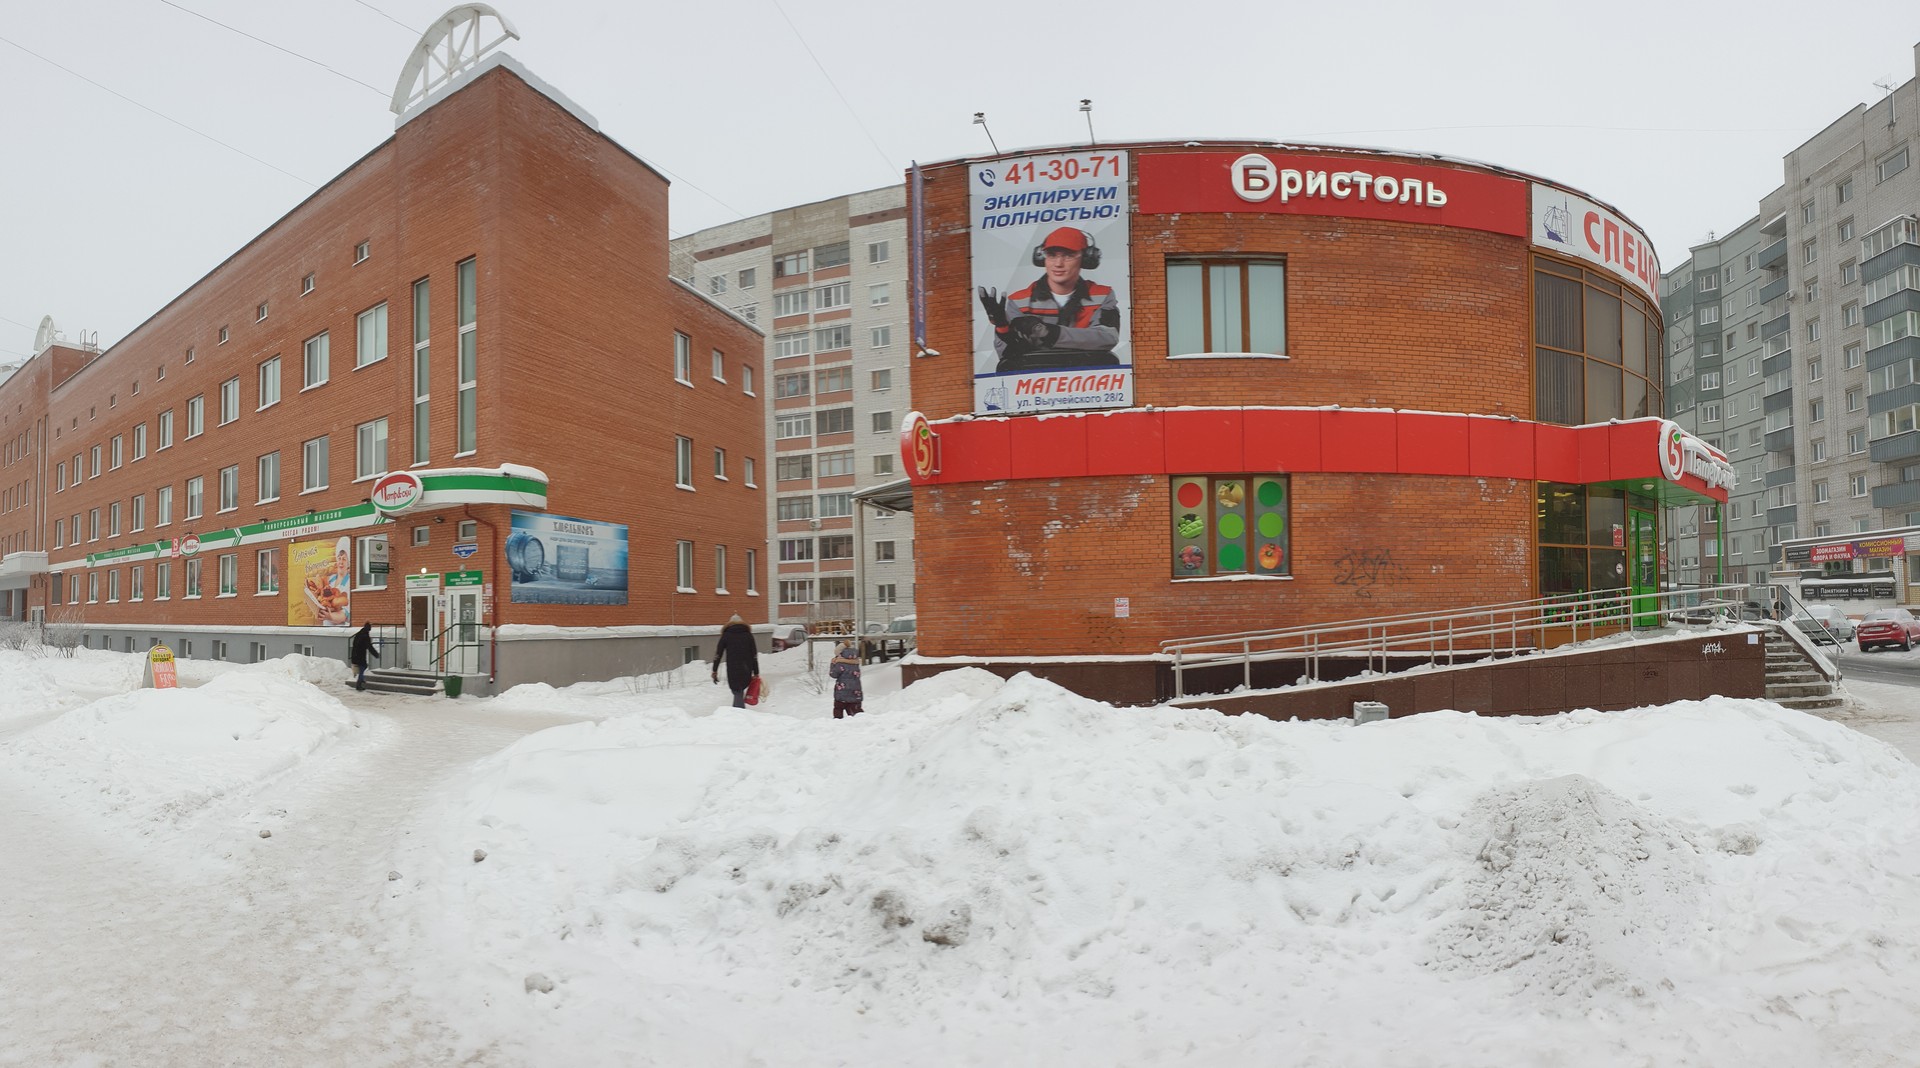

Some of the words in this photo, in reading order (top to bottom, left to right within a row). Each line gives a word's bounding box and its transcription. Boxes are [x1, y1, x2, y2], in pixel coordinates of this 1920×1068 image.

[1005, 155, 1120, 184] 41-30-71
[1231, 154, 1448, 208] Бристоль
[983, 186, 1118, 211] ЭКИПИРУЕМ
[981, 205, 1121, 230] ПОЛНОСТЬЮ!
[1015, 373, 1125, 396] МАГЕЛЛАН
[1017, 400, 1032, 409] ул.
[1034, 394, 1102, 407] Выучейского
[1104, 392, 1124, 402] 28/2
[314, 511, 342, 522] МАГАЗИН
[1816, 546, 1847, 555] ЗООМАГАЗИН
[1833, 552, 1851, 560] ФАУНА
